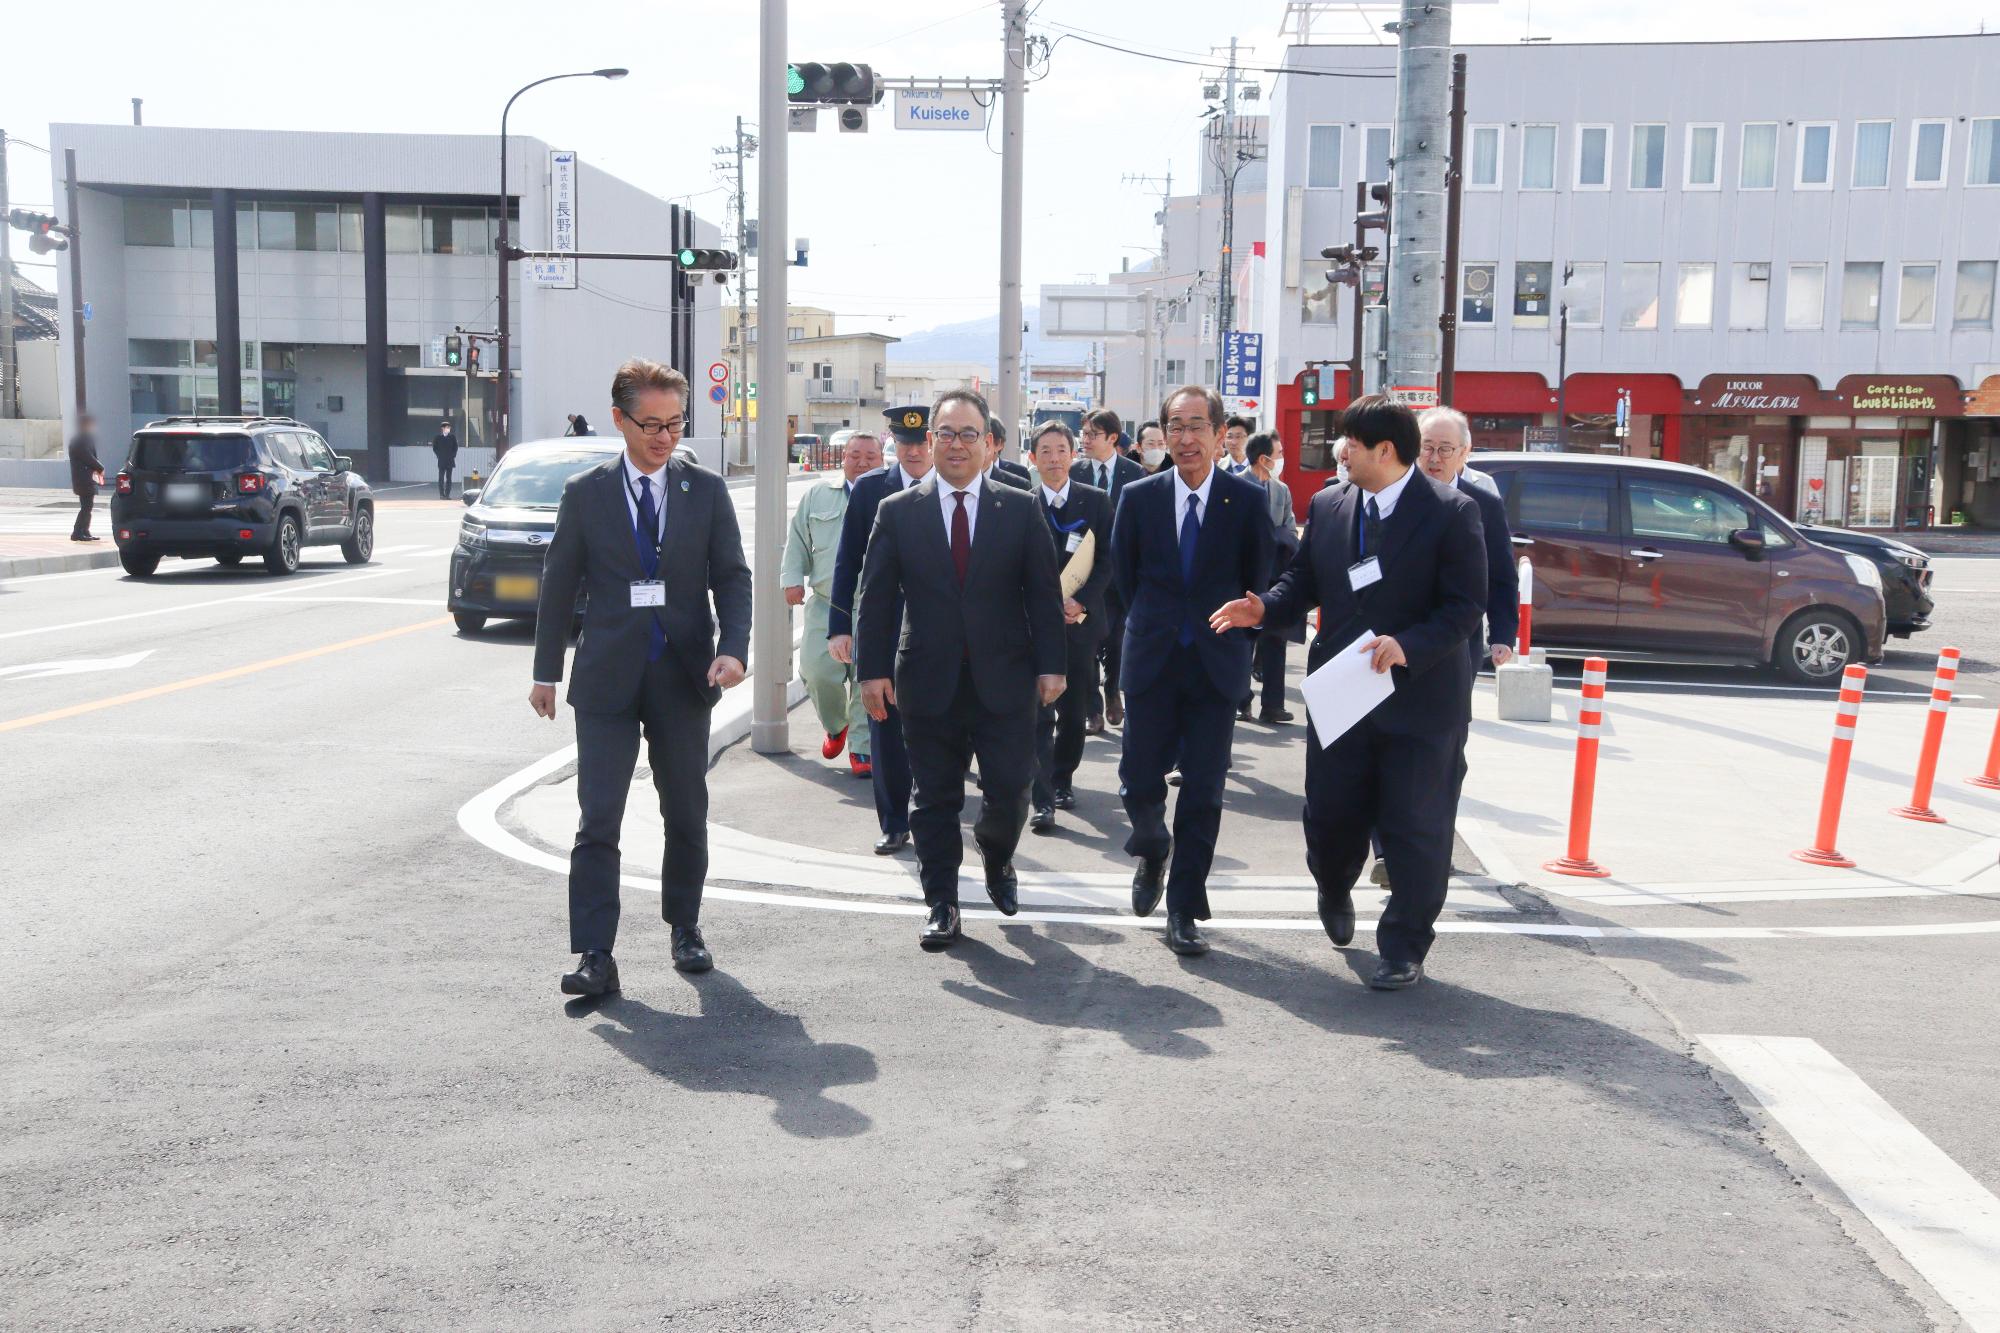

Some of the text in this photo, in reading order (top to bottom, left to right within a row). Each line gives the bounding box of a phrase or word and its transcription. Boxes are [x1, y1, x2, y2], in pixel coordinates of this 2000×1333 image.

[901, 90, 943, 101] Chikuma City
[910, 105, 970, 121] Kuiseke
[1225, 334, 1240, 395] どうぶつ病院
[713, 368, 724, 377] 50
[1726, 381, 1763, 391] LIQUOR
[1866, 384, 1925, 394] Cafe Bar
[1711, 392, 1801, 409] MIYAZAWA
